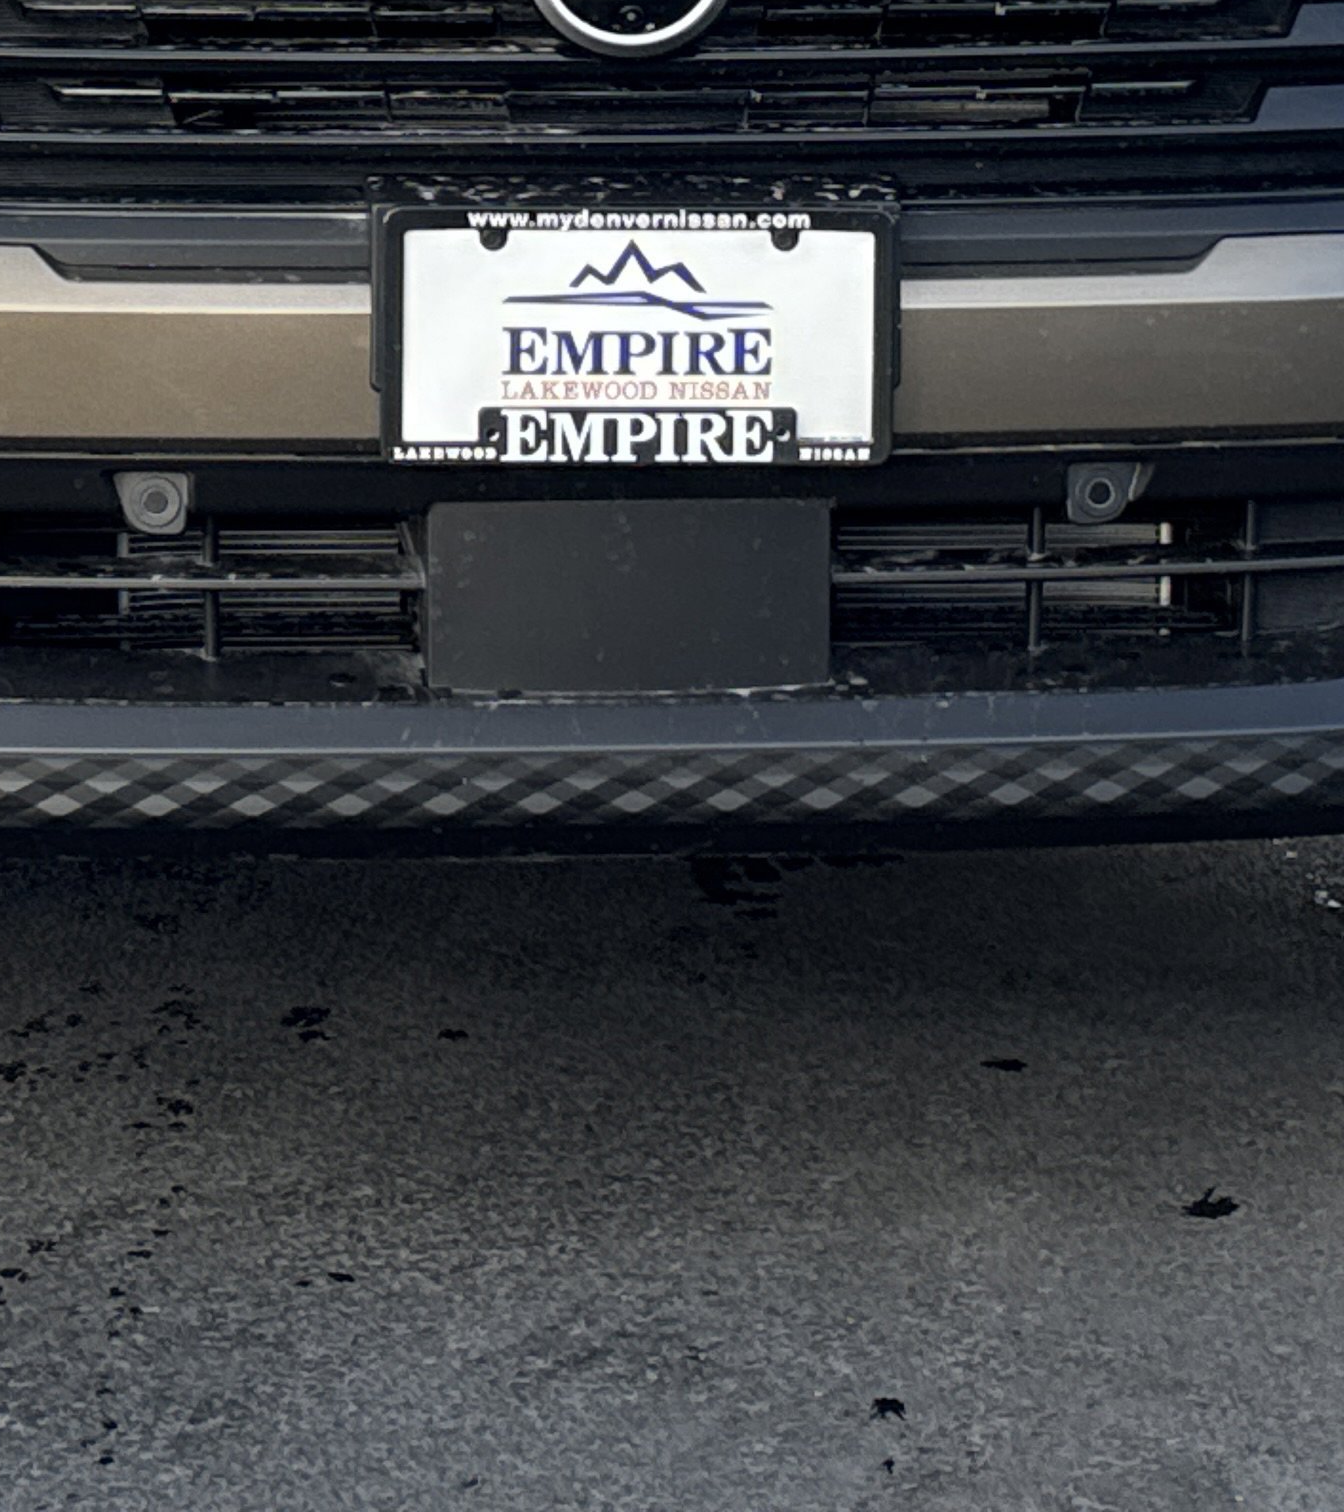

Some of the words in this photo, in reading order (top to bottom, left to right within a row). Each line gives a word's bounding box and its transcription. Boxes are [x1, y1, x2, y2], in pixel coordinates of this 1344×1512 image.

[467, 209, 812, 231] www.mydenvernissan.com
[502, 327, 773, 376] EMPIRE
[502, 381, 656, 400] LAKEWOOD
[669, 381, 773, 400] NISSAN
[393, 447, 498, 461] LAKEWOOD
[499, 408, 774, 463] EMPIRE
